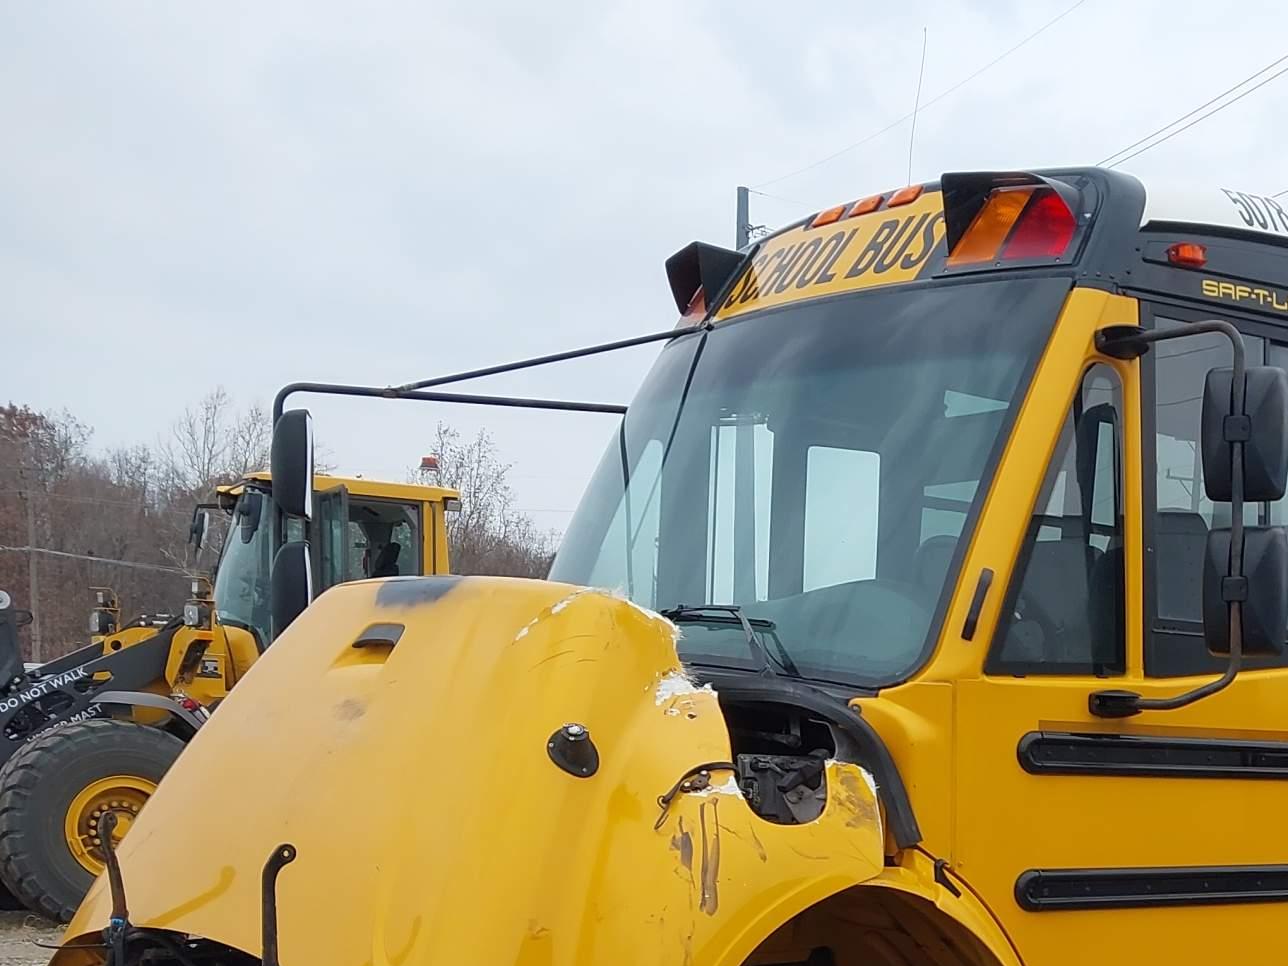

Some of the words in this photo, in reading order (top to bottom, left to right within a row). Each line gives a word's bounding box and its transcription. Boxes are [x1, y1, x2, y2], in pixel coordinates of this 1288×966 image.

[724, 227, 858, 310] SCHOOL
[844, 210, 948, 280] BUS
[0, 697, 19, 713] DO
[20, 683, 49, 703] NOT
[48, 666, 89, 689] WALK
[70, 703, 103, 723] MAST
